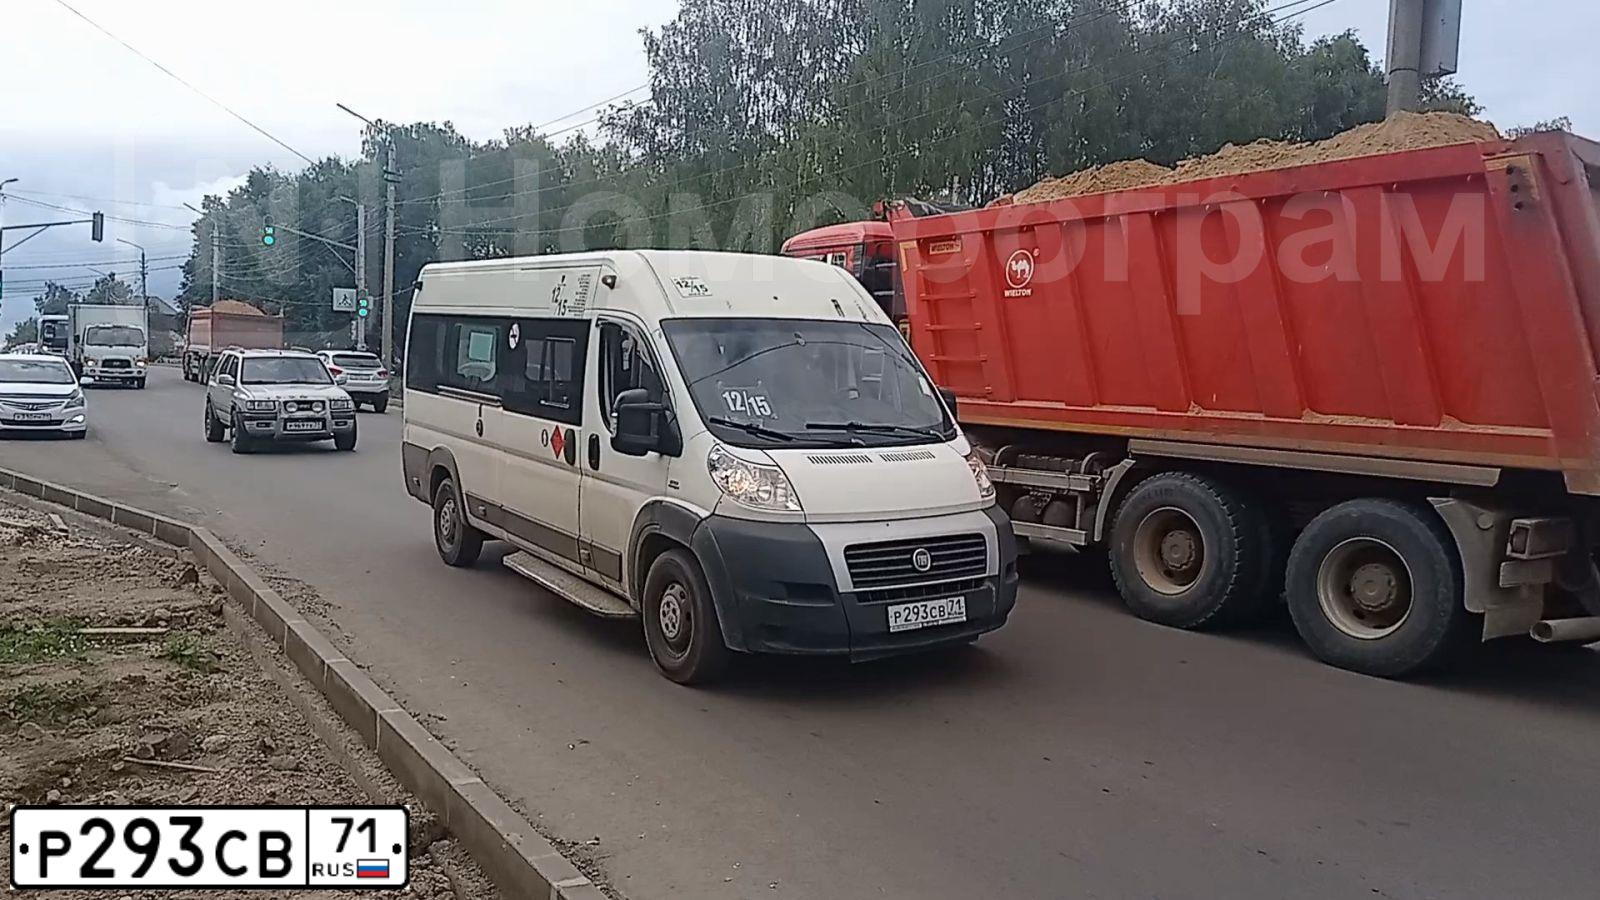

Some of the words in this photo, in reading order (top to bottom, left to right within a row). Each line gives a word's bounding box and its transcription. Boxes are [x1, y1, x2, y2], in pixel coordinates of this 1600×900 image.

[1004, 288, 1032, 298] WIELTON
[722, 390, 772, 417] 12/15
[893, 603, 946, 623] Р293СВ
[948, 598, 962, 611] 71
